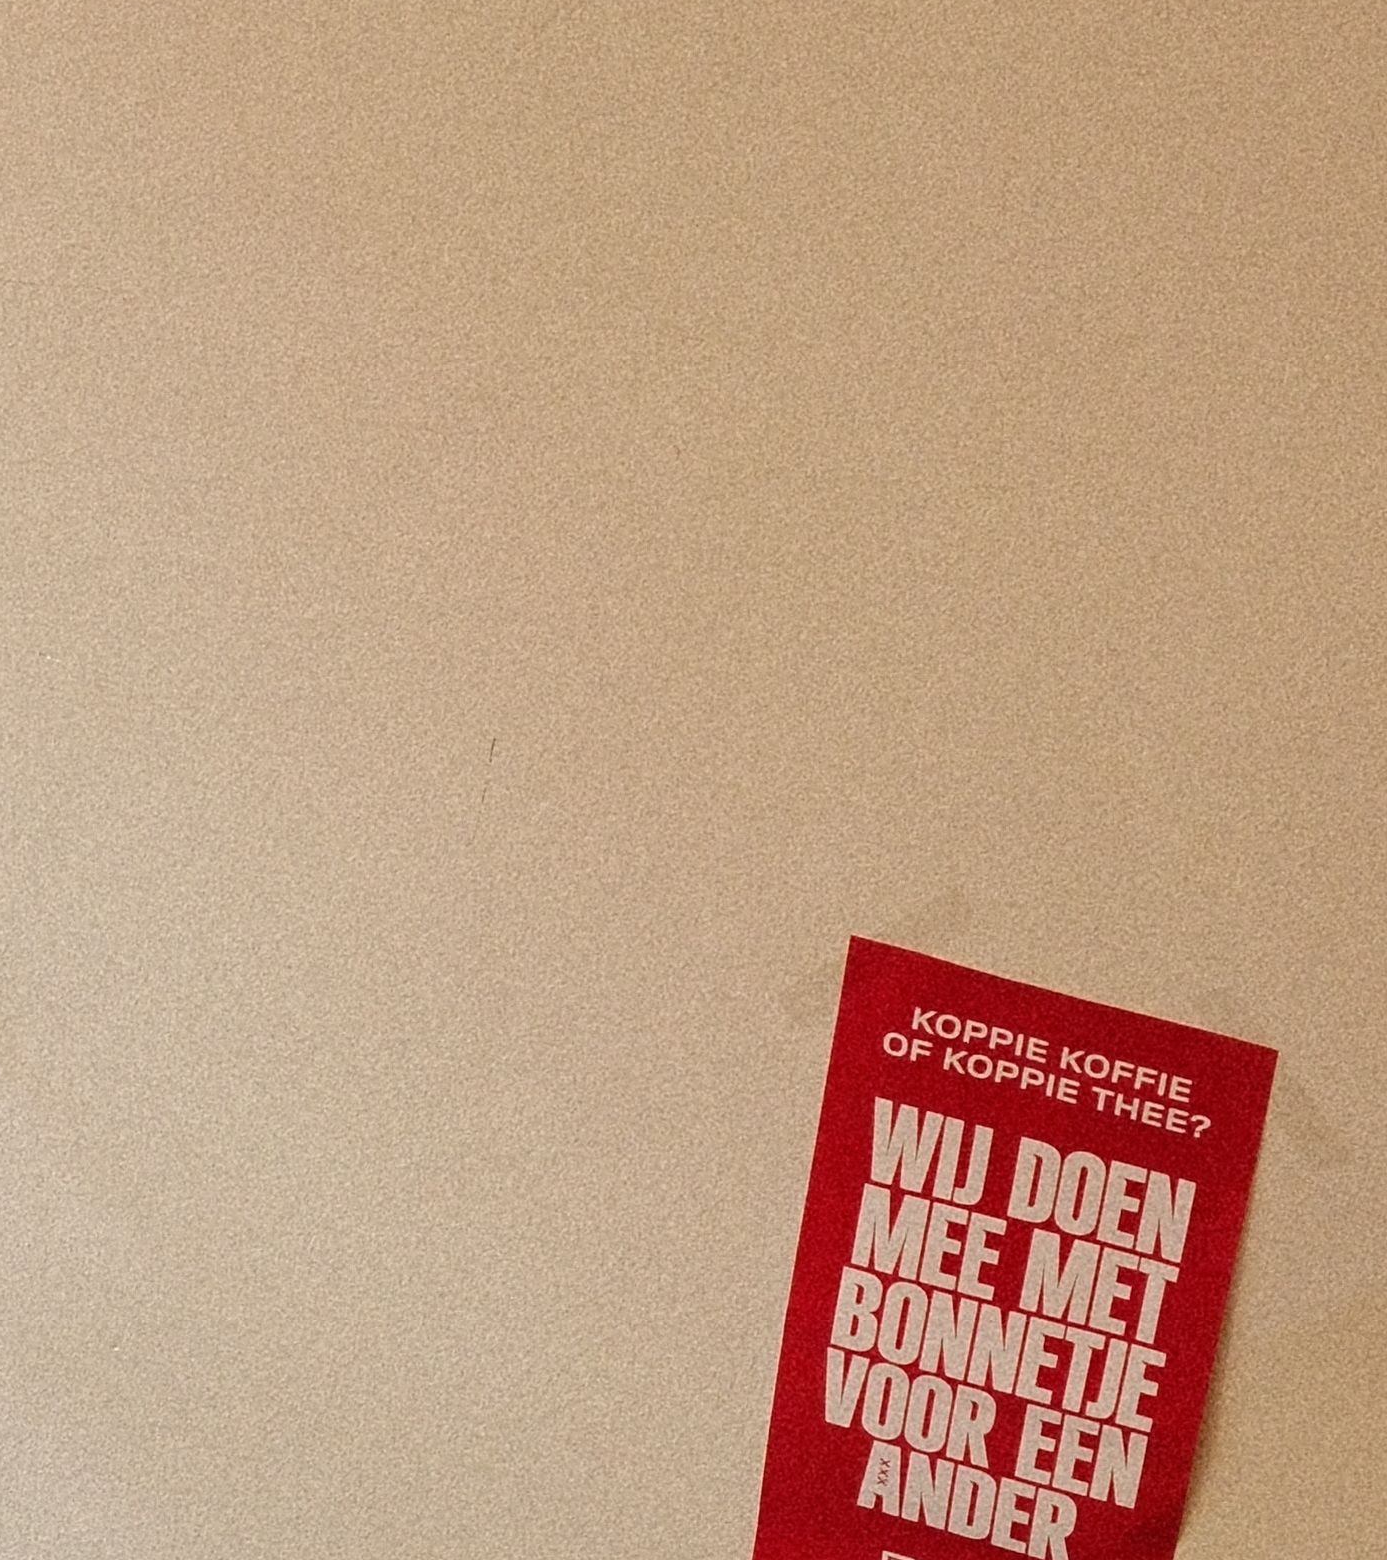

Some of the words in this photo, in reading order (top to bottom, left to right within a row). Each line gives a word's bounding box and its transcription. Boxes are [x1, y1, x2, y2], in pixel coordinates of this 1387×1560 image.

[882, 1031, 934, 1063] OF
[942, 1046, 1081, 1105] KOPPIE
[1091, 1085, 1212, 1139] THEE?
[911, 1006, 1051, 1065] KOPPIE
[1059, 1046, 1194, 1104] KOFFIE
[870, 1095, 994, 1206] WIJ
[1006, 1136, 1198, 1264] DOEN
[850, 1182, 1008, 1301] MEE
[1019, 1227, 1180, 1344] MET
[824, 1346, 997, 1469] VOOR
[1014, 1403, 1149, 1510] EEN
[830, 1265, 1167, 1432] BONNETJE
